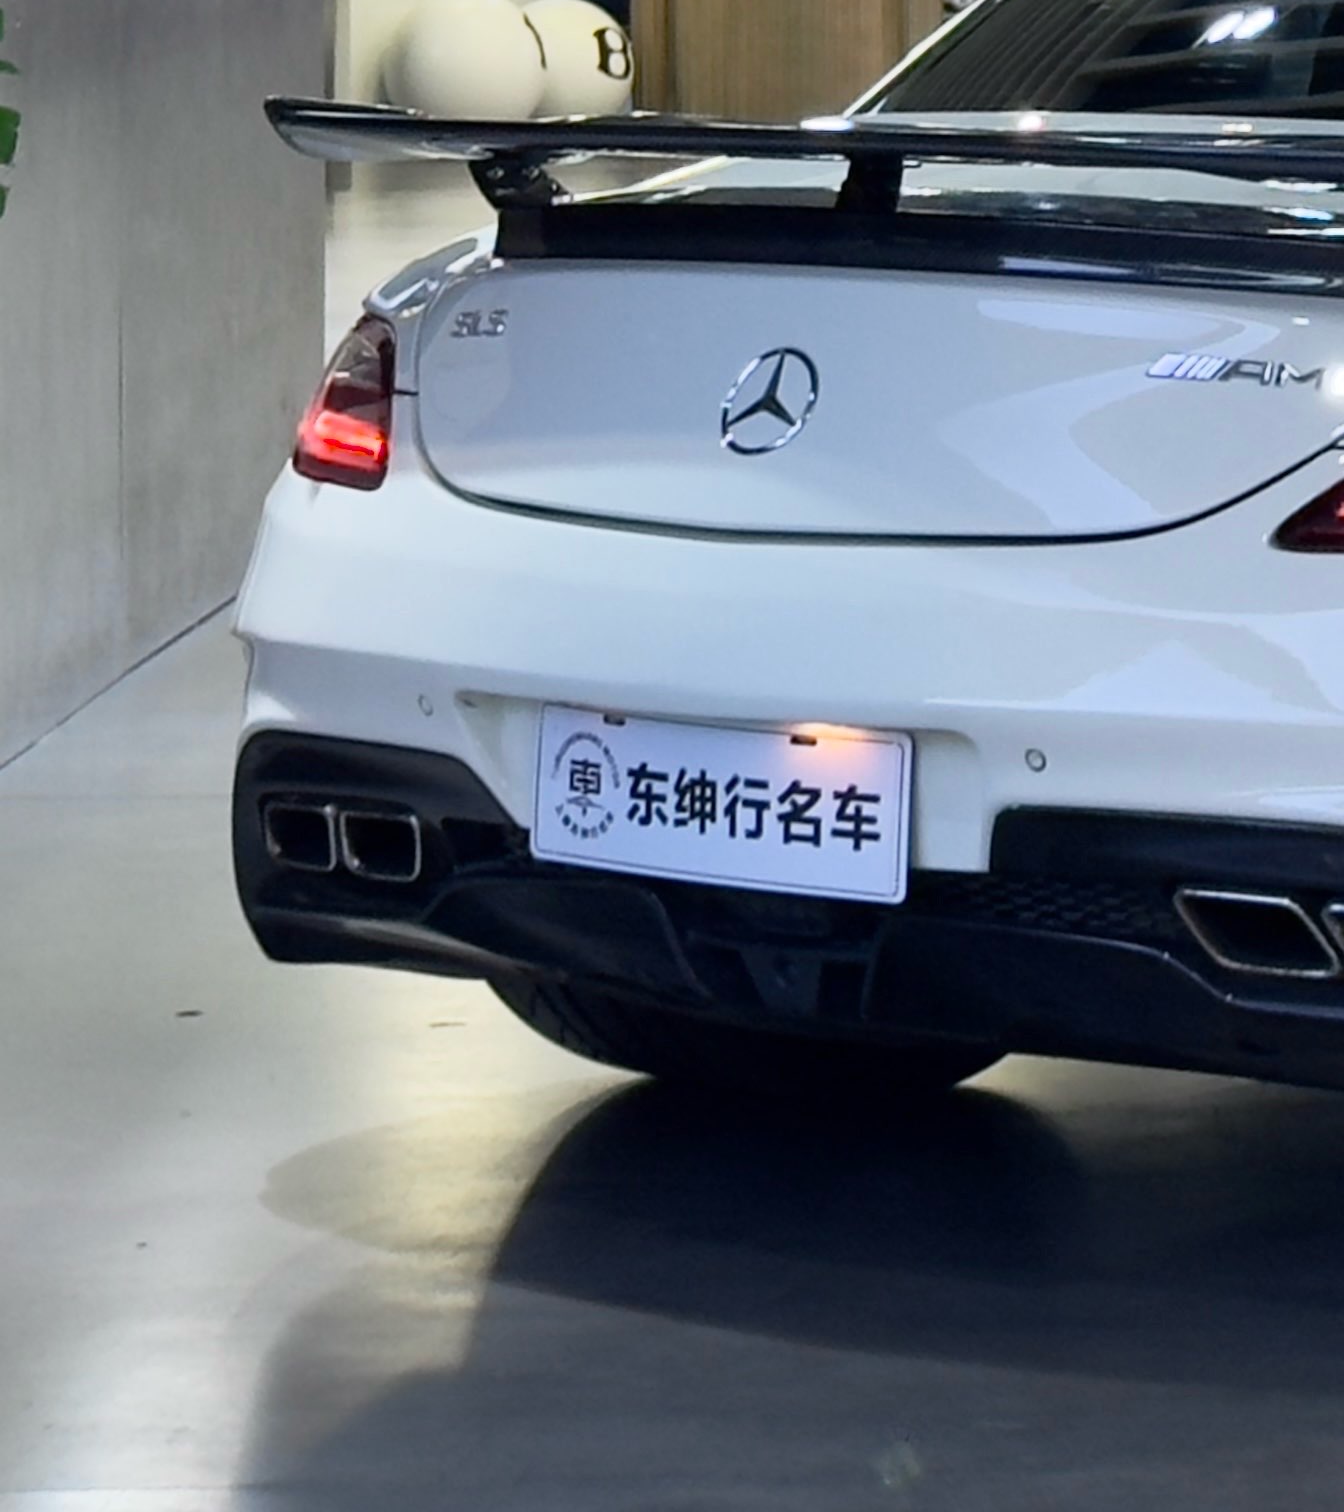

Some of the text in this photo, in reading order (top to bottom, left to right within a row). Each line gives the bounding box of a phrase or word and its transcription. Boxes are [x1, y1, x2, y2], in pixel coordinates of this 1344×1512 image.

[625, 761, 881, 852] 东绅行名车
